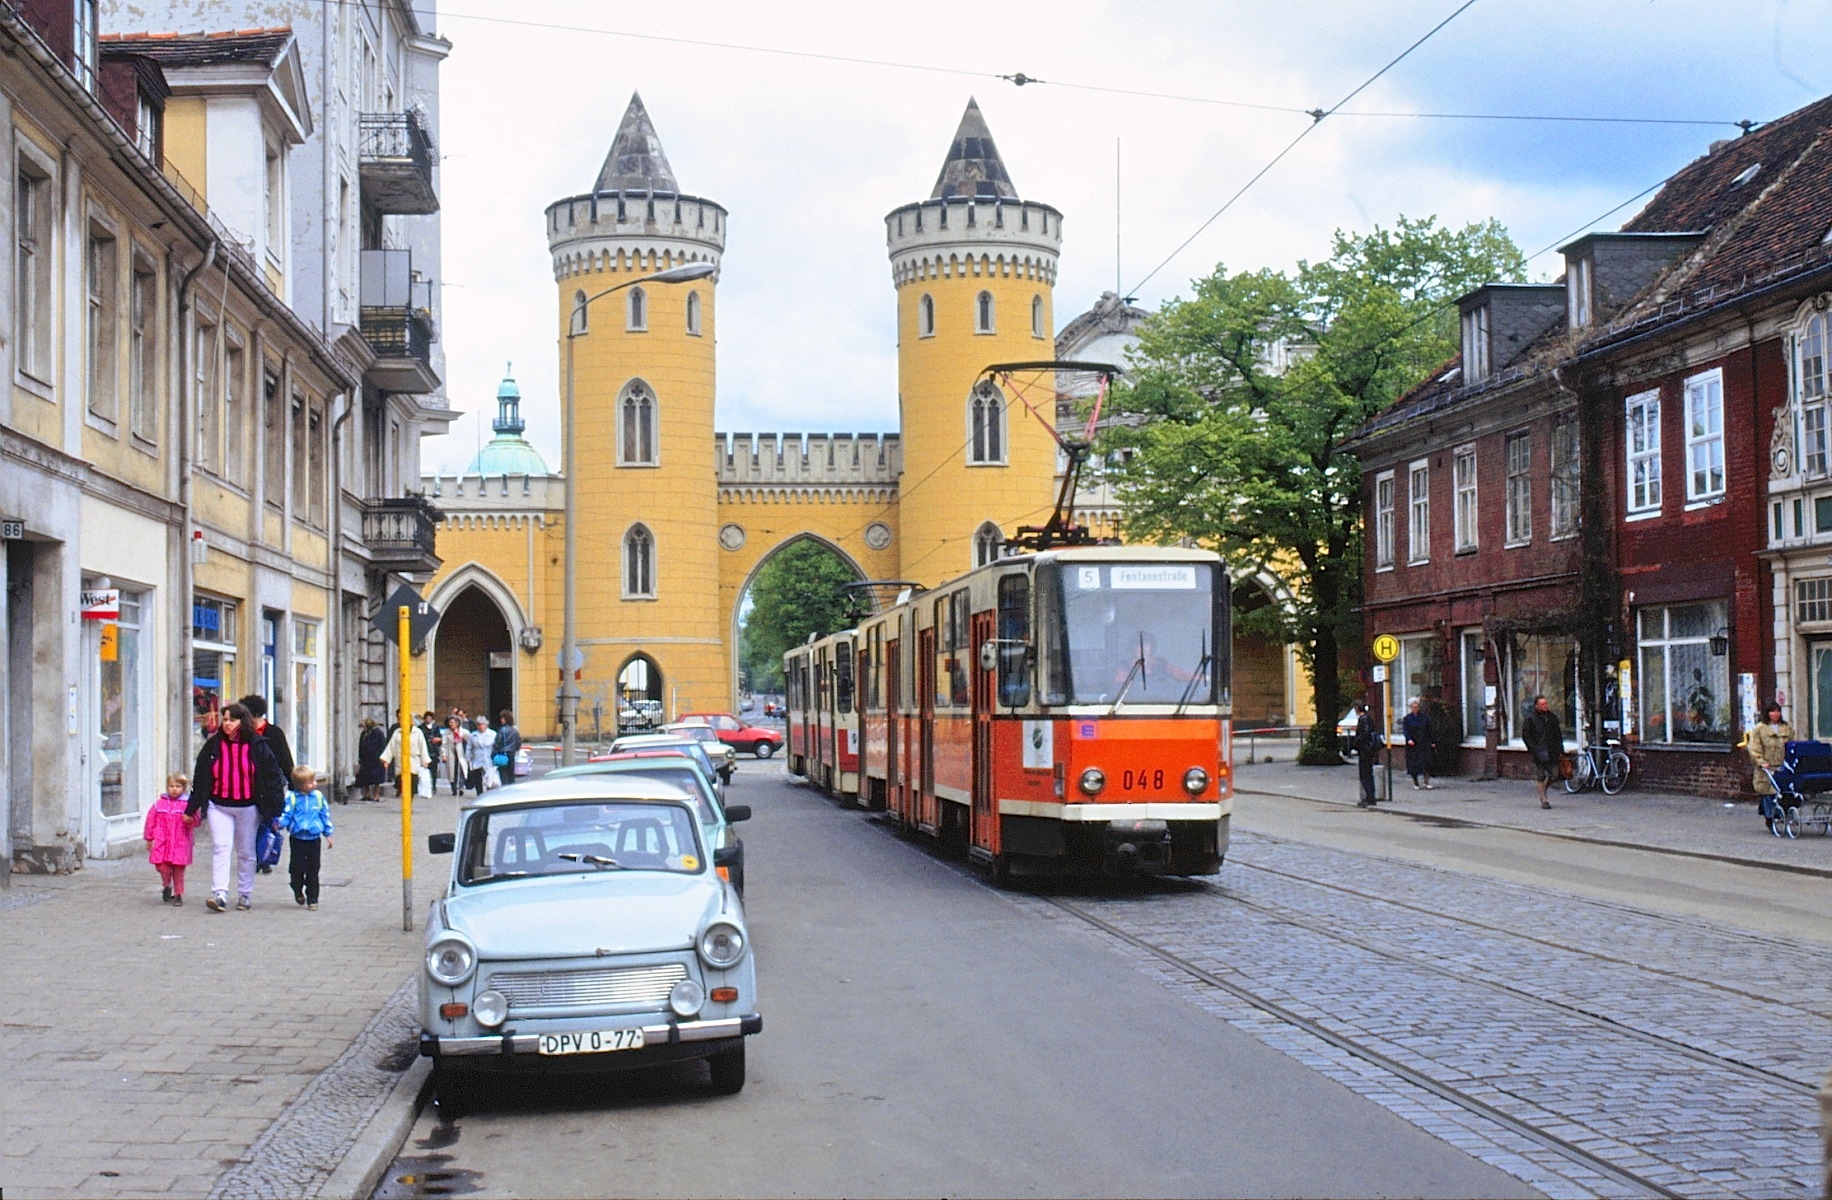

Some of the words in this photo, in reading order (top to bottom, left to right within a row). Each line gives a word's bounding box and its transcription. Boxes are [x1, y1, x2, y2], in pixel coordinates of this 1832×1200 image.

[4, 523, 20, 536] 86
[1085, 571, 1093, 583] 5
[80, 592, 112, 606] West
[1381, 640, 1392, 655] H
[1123, 769, 1164, 790] 048
[546, 1034, 583, 1053] DPV
[591, 1030, 636, 1050] 0-77
